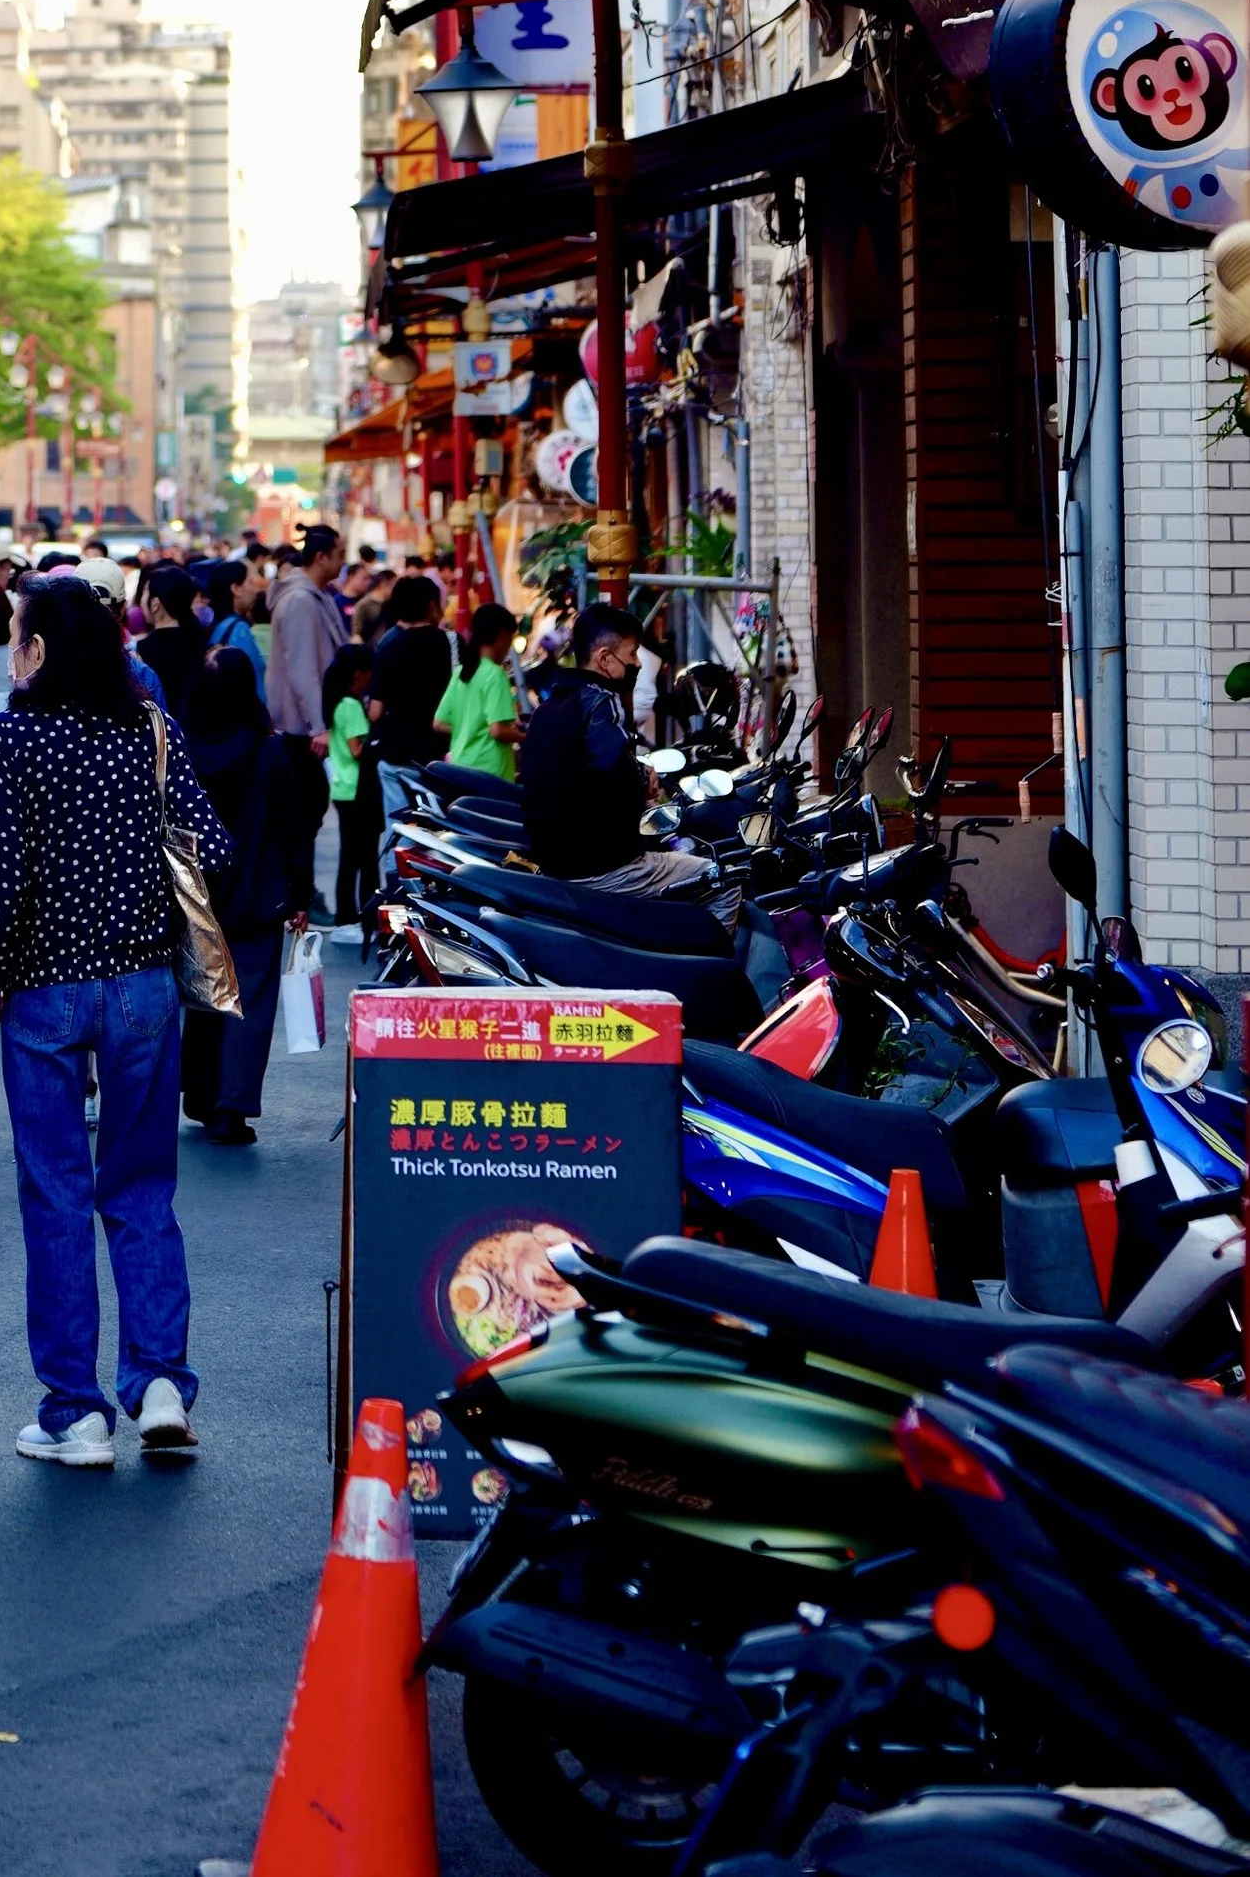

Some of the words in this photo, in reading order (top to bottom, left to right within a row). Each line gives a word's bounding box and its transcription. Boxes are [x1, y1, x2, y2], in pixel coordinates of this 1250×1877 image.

[554, 1005, 602, 1016] RAMEN
[555, 1023, 635, 1042] 赤羽拉麵
[553, 1047, 602, 1058] ラーメン
[390, 1099, 568, 1128] 濃厚豚骨拉麵
[390, 1128, 622, 1153] 濃厚とんこつラーメン
[391, 1157, 445, 1177] Thick
[449, 1159, 541, 1178] Tonkotsu
[545, 1161, 617, 1179] Ramen
